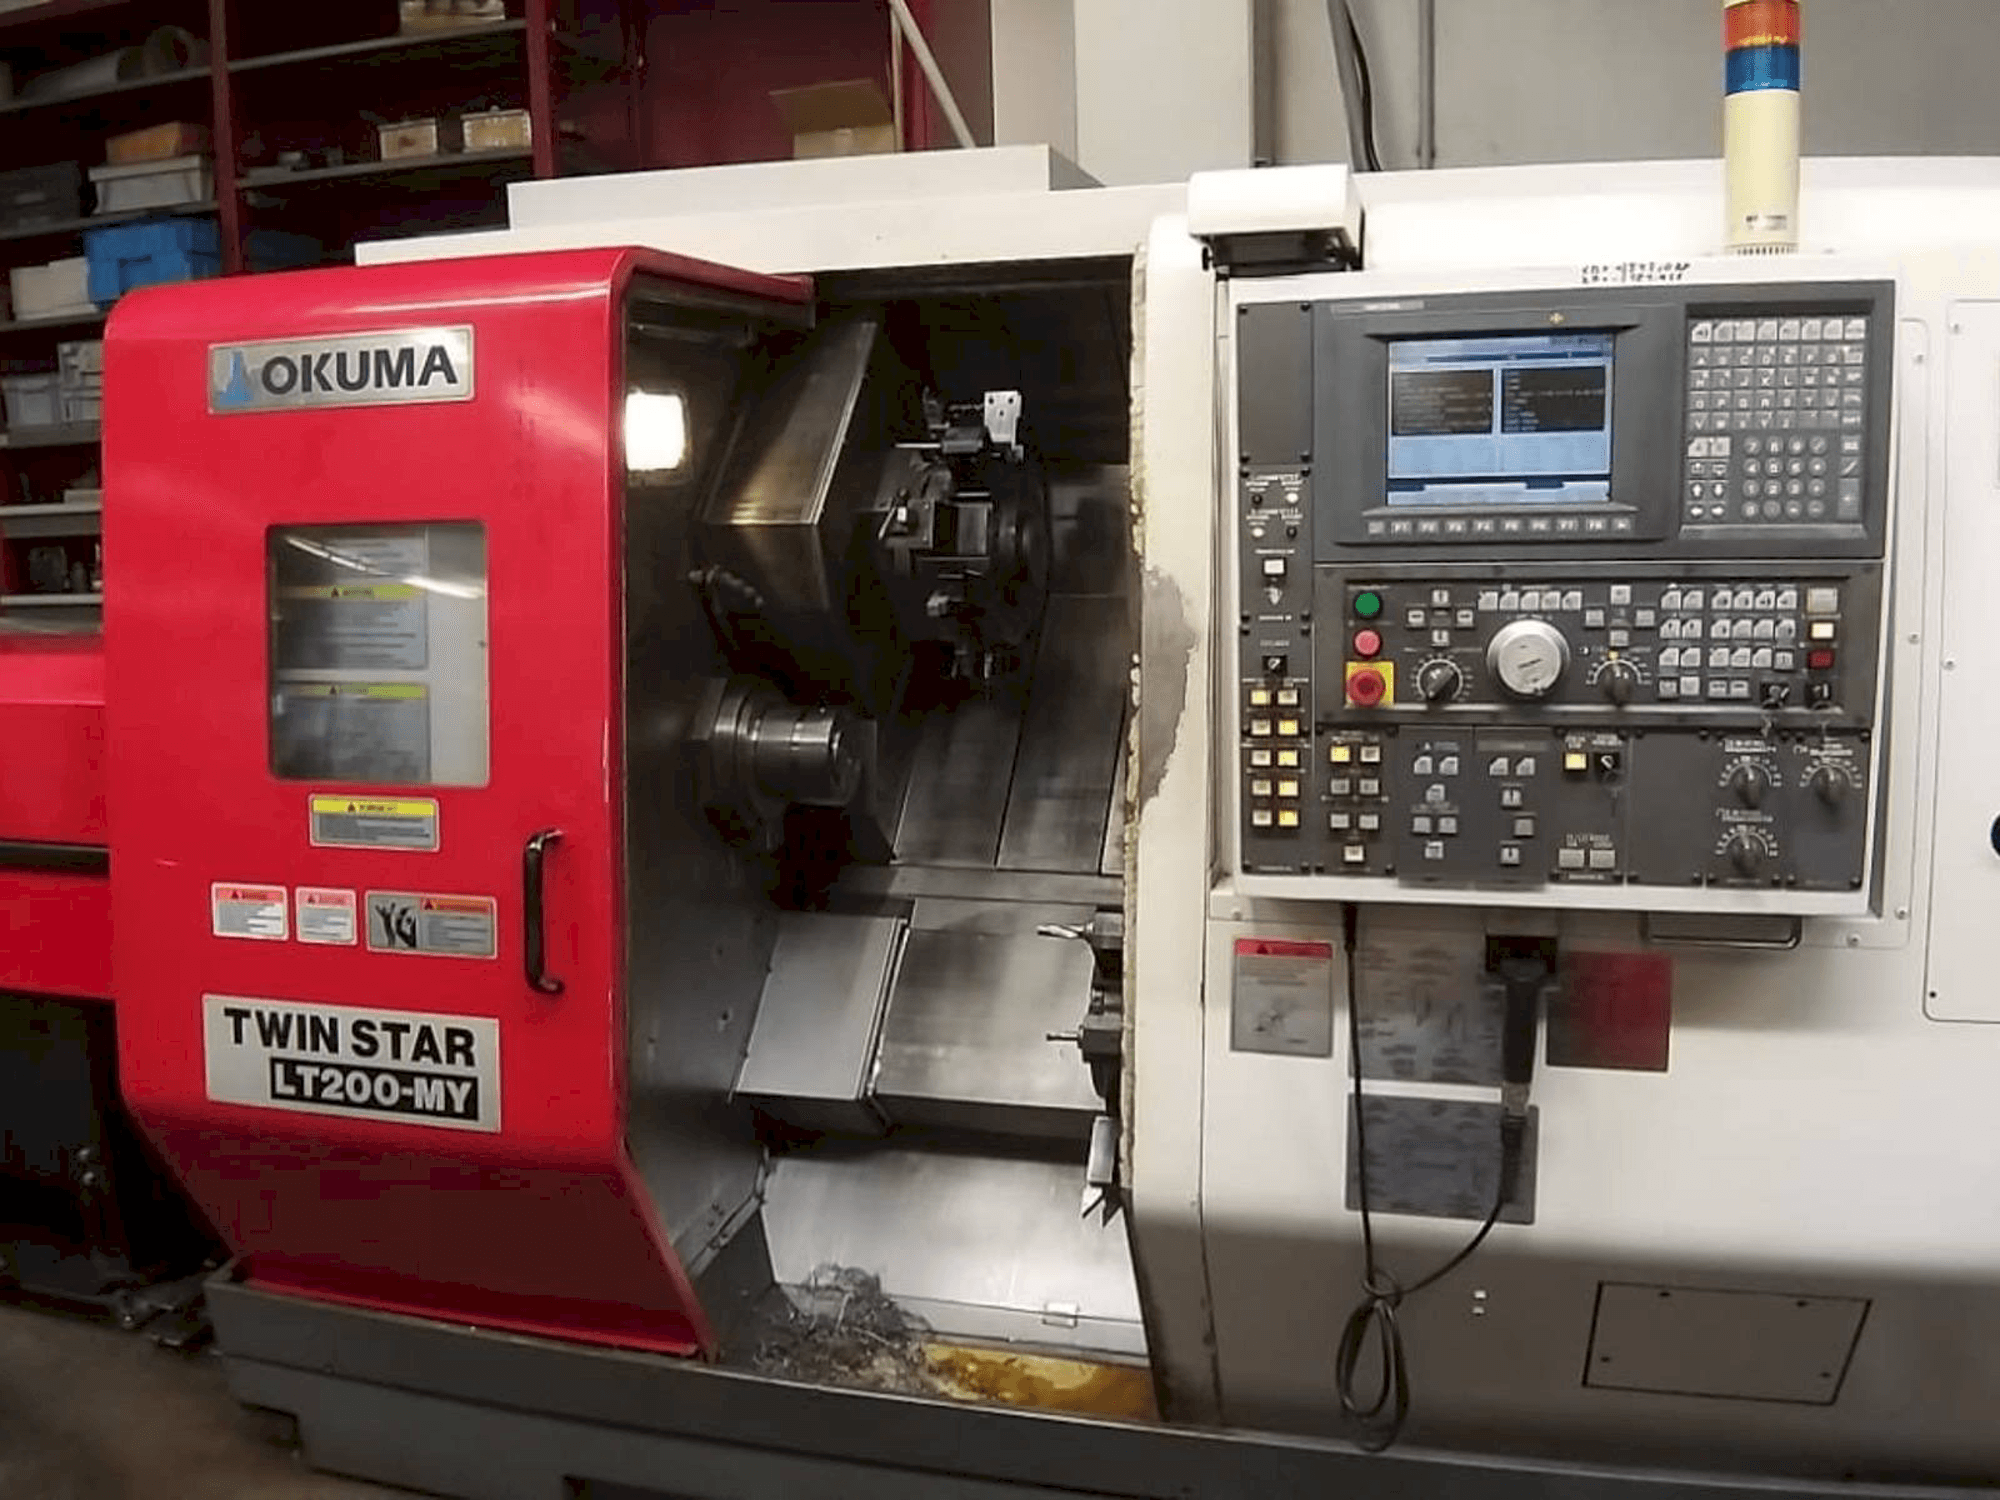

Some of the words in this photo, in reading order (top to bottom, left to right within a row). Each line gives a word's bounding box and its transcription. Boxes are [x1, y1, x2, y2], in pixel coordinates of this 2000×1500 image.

[261, 345, 458, 395] OKUMA
[224, 1007, 340, 1055] TWIN
[351, 1018, 476, 1067] STAR
[274, 1063, 473, 1114] LT200-MY
